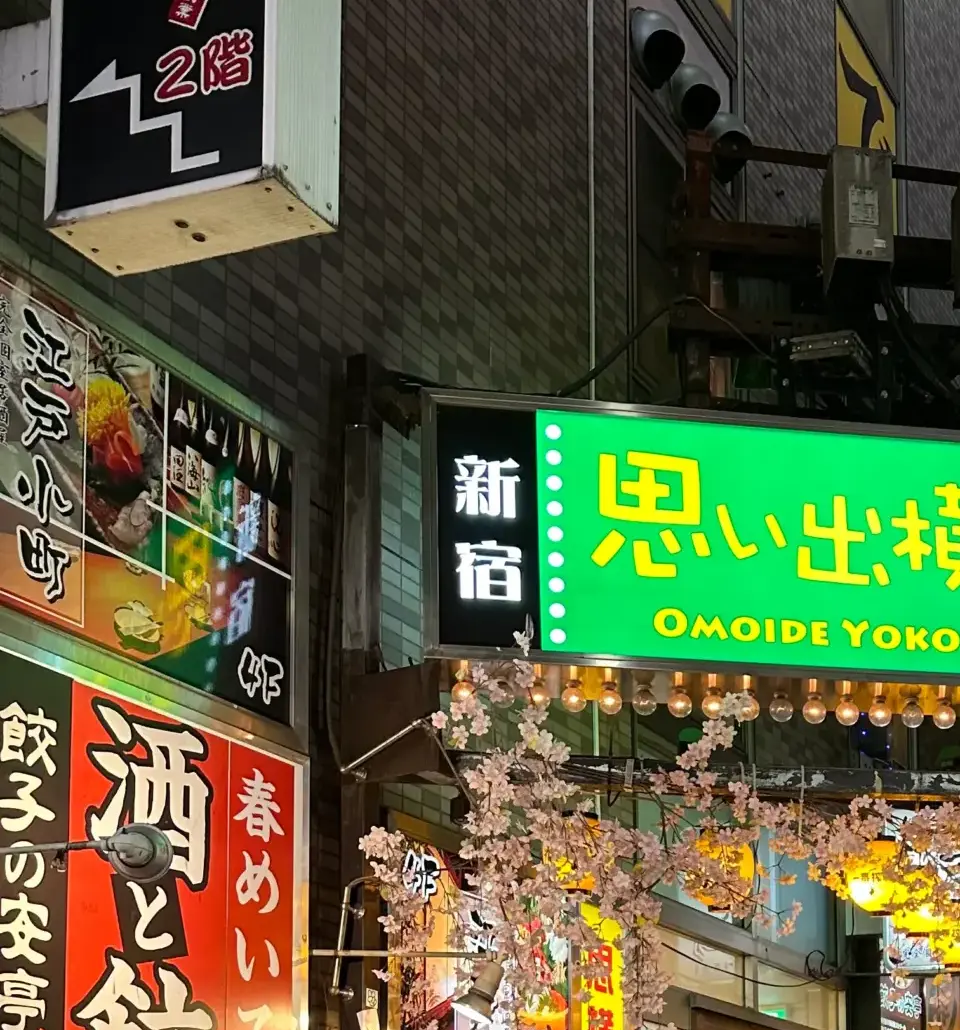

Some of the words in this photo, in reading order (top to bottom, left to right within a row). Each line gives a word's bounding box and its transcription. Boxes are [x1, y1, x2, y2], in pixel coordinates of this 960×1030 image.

[155, 29, 253, 102] 2階
[454, 454, 522, 602] 新宿
[653, 608, 830, 647] OMOIDE
